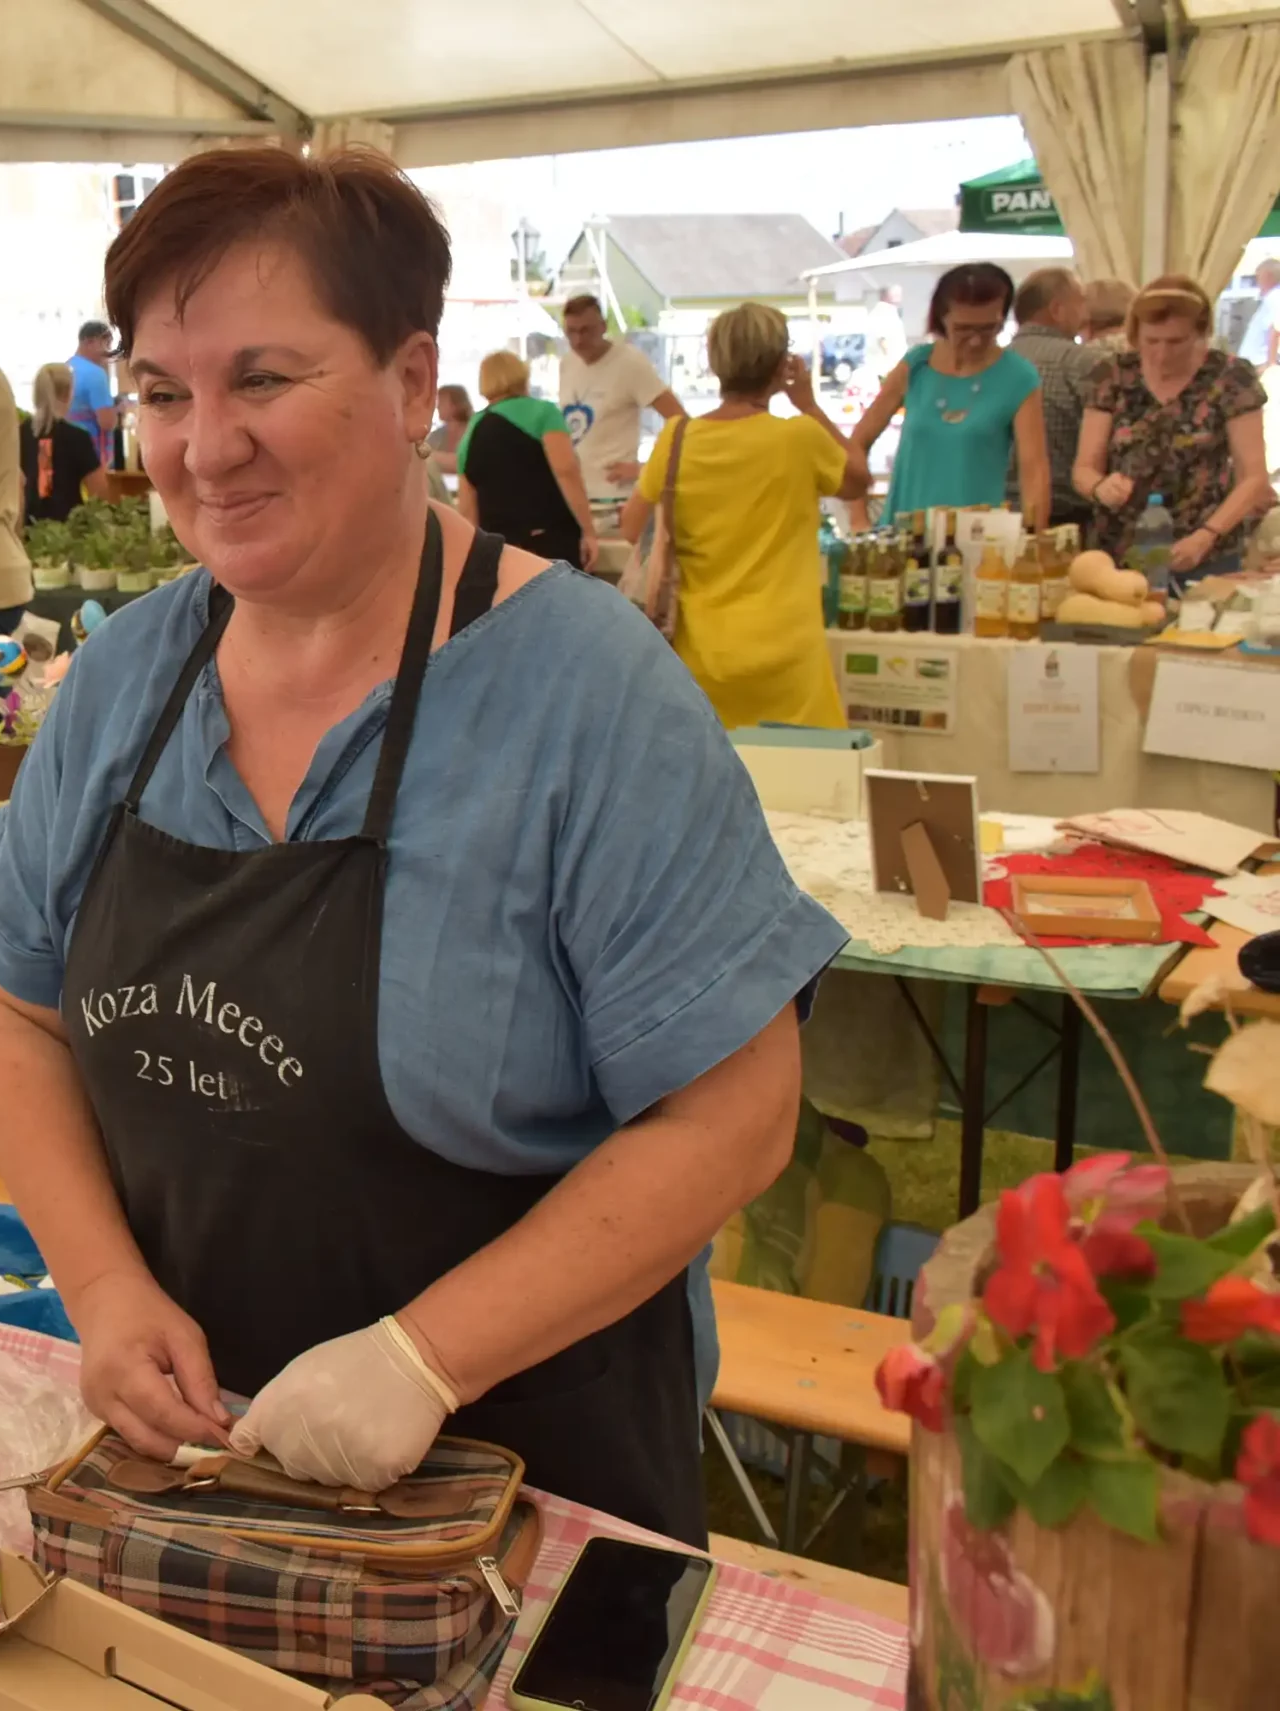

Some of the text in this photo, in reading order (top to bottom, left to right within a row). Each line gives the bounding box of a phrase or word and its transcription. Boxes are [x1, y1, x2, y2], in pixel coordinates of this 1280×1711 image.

[991, 190, 1052, 213] PAN
[81, 973, 304, 1088] Koza Meeee
[134, 1049, 174, 1086] 25
